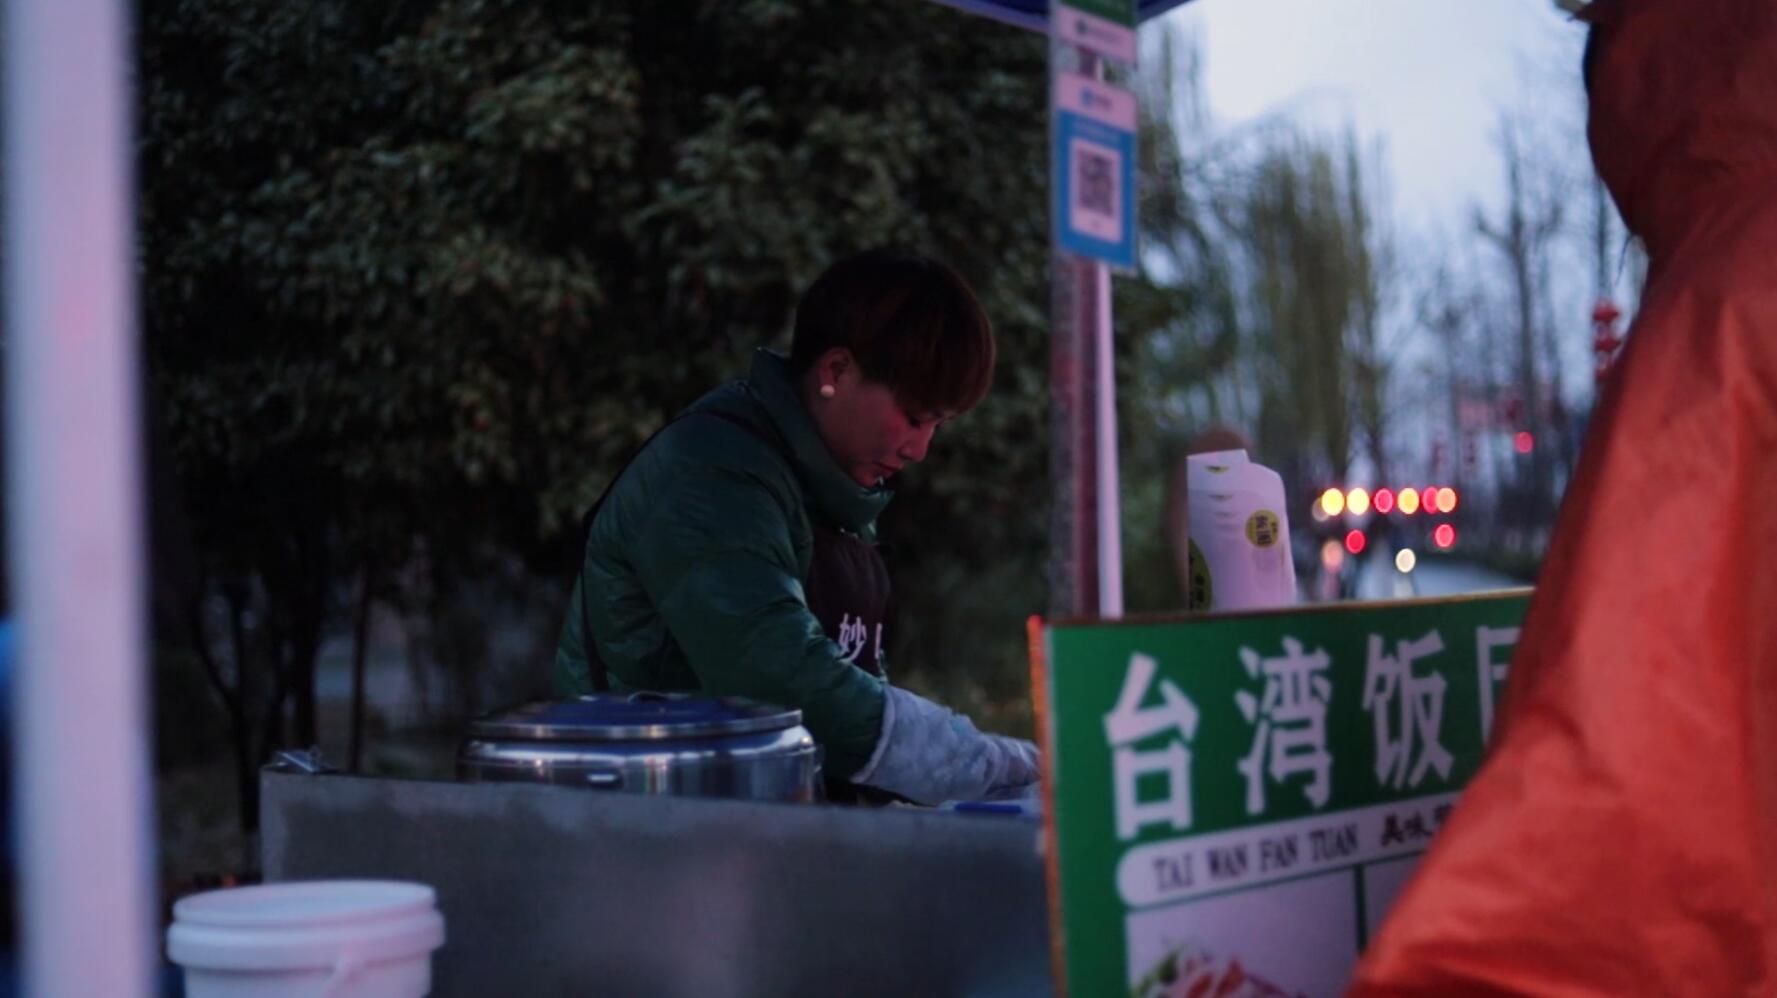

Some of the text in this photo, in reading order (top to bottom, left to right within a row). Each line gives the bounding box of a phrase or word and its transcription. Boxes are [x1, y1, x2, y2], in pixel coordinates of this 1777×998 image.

[838, 613, 883, 663] 妙
[1153, 823, 1358, 892] TAI WAN FAN TUAN
